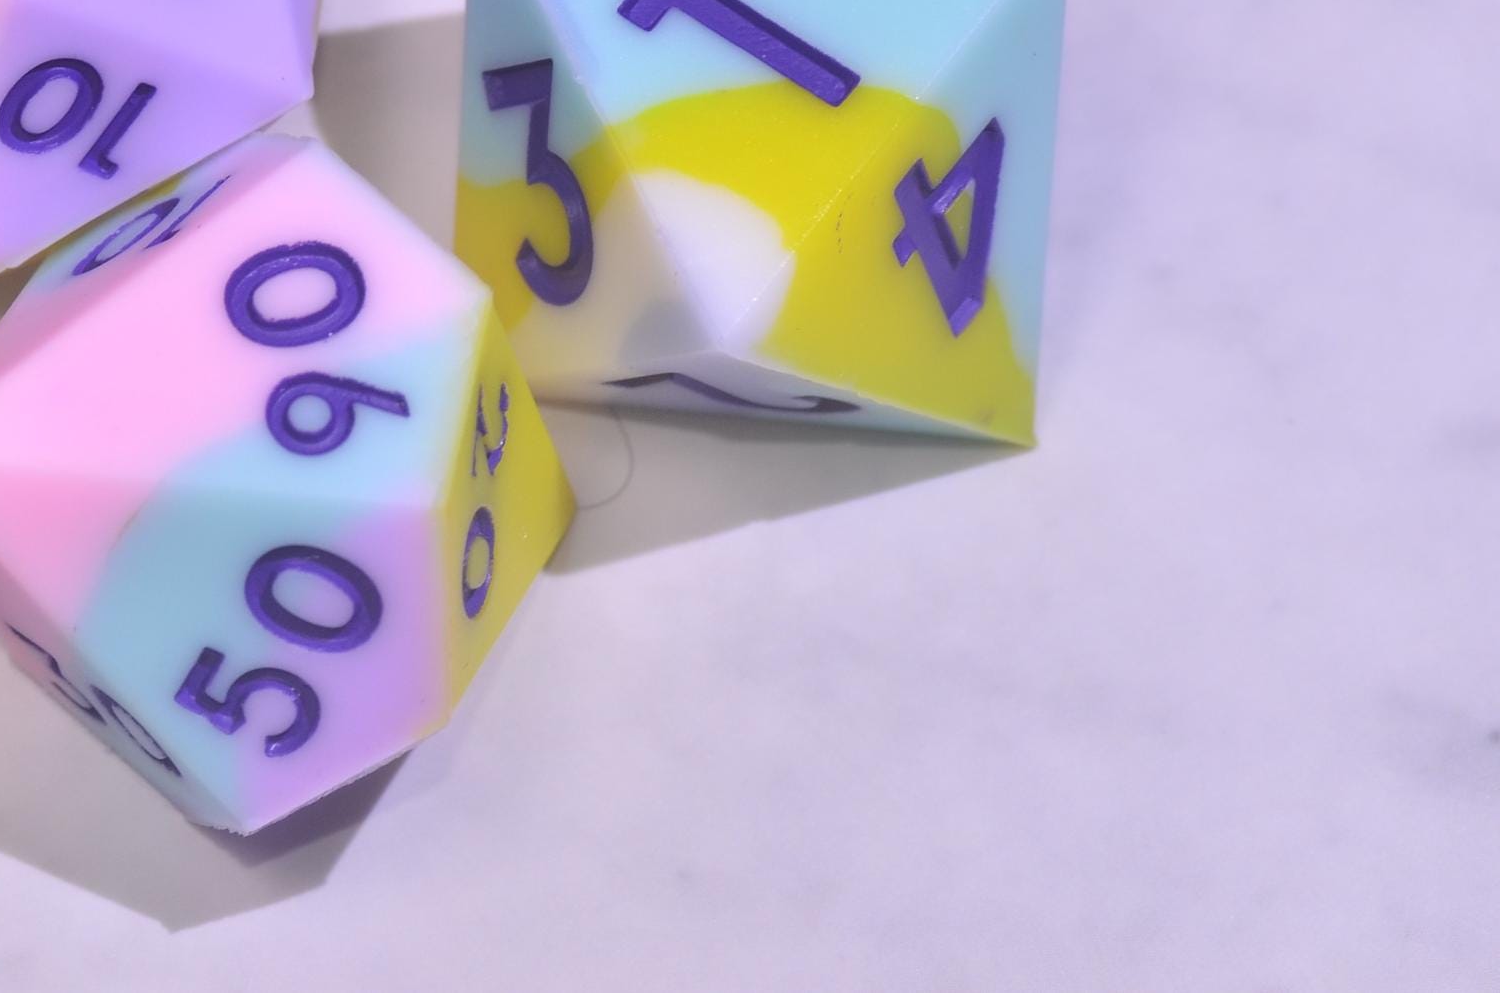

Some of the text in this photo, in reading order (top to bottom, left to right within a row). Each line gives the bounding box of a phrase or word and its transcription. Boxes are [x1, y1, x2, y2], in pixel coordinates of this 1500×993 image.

[482, 57, 594, 307] 3
[892, 117, 1006, 338] 4
[223, 240, 411, 456] 90
[600, 372, 862, 413] 2
[460, 380, 510, 621] 20
[174, 544, 383, 758] 50
